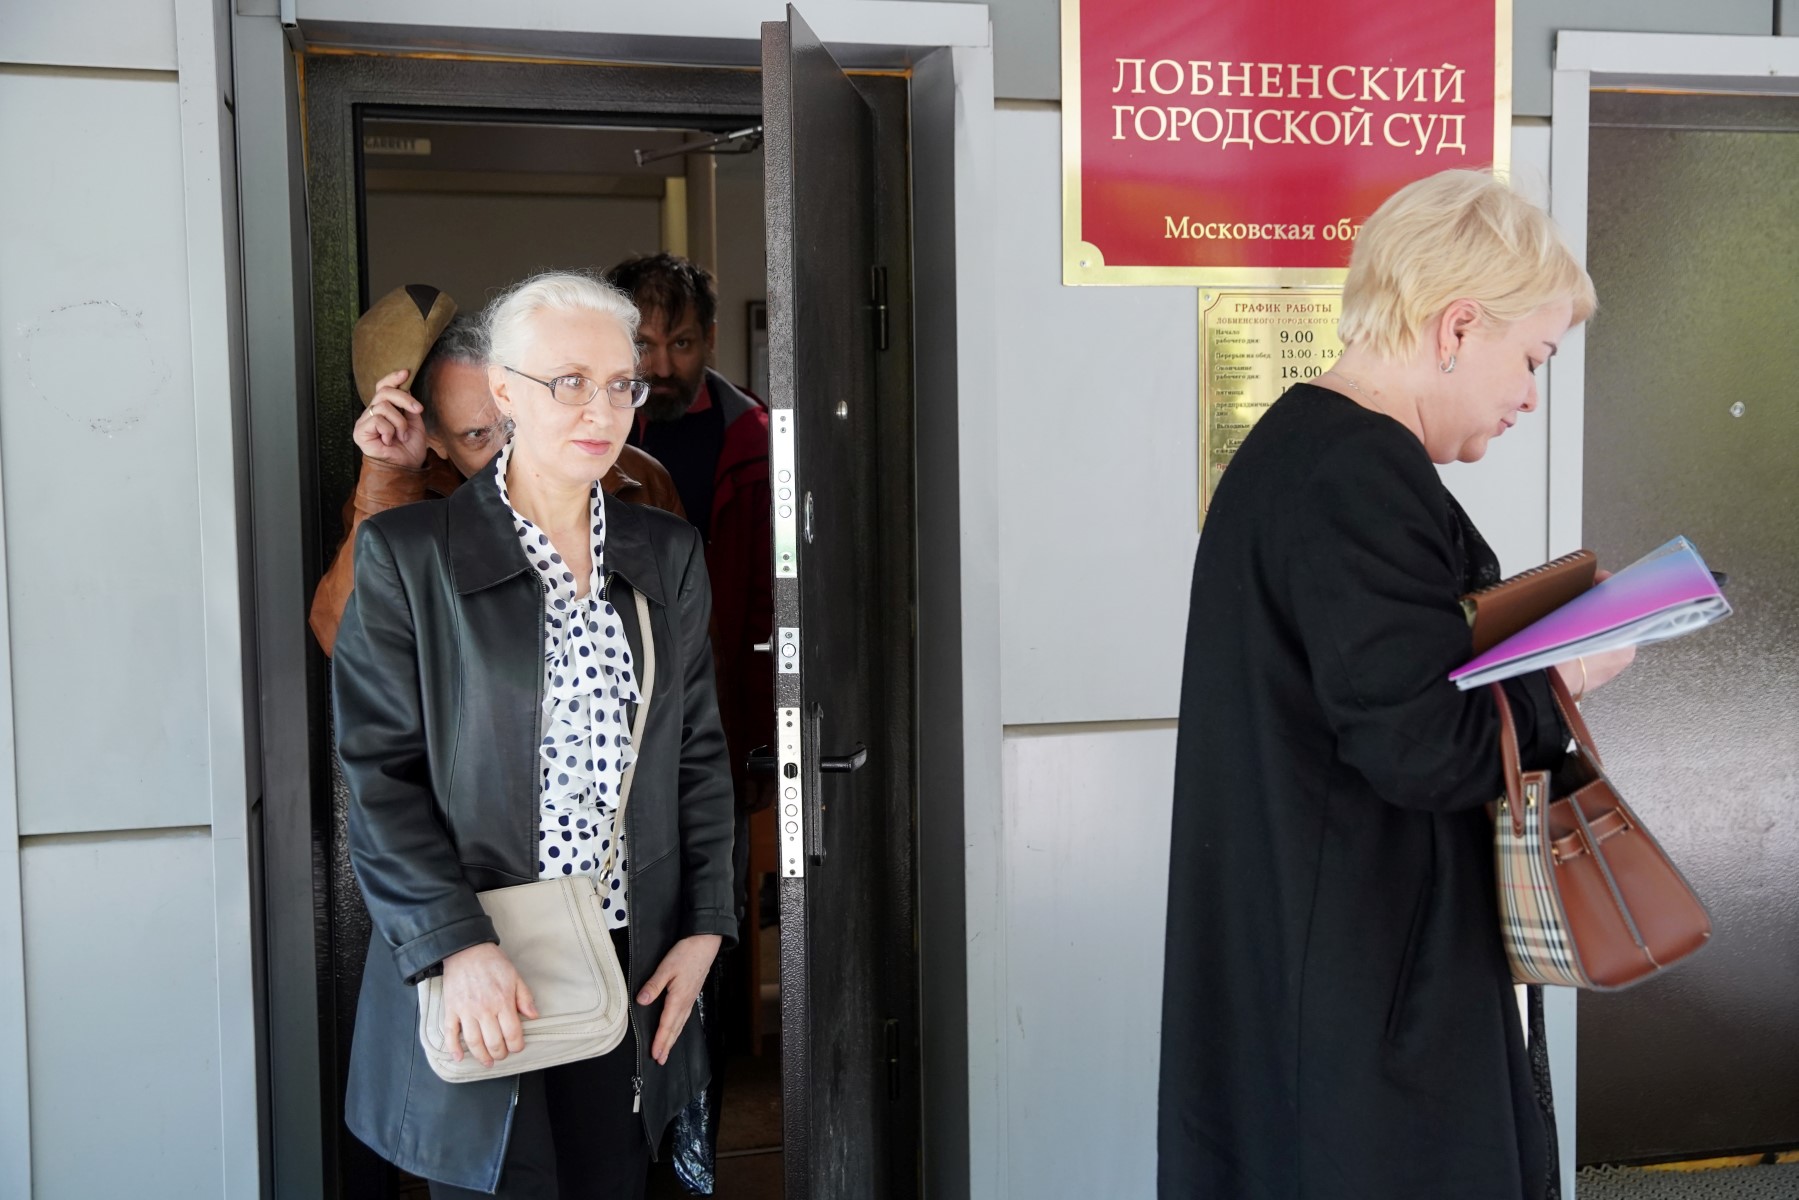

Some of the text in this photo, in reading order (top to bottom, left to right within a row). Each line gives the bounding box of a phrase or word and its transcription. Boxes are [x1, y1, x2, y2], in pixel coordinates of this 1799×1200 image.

[1112, 57, 1466, 103] ЛОБНЕНСКИЙ
[1112, 104, 1466, 156] ГОРОДСКОЙ СУД
[1164, 216, 1316, 240] Московская
[1234, 303, 1332, 313] ГРАФИК РАБОТЫ
[1216, 317, 1275, 325] ЛОБНЕНСКОГО
[1277, 317, 1328, 325] ГОРОДСКОГО
[1280, 330, 1314, 343] 9.00
[1281, 349, 1312, 358] 13.00
[1281, 366, 1322, 378] 18.00
